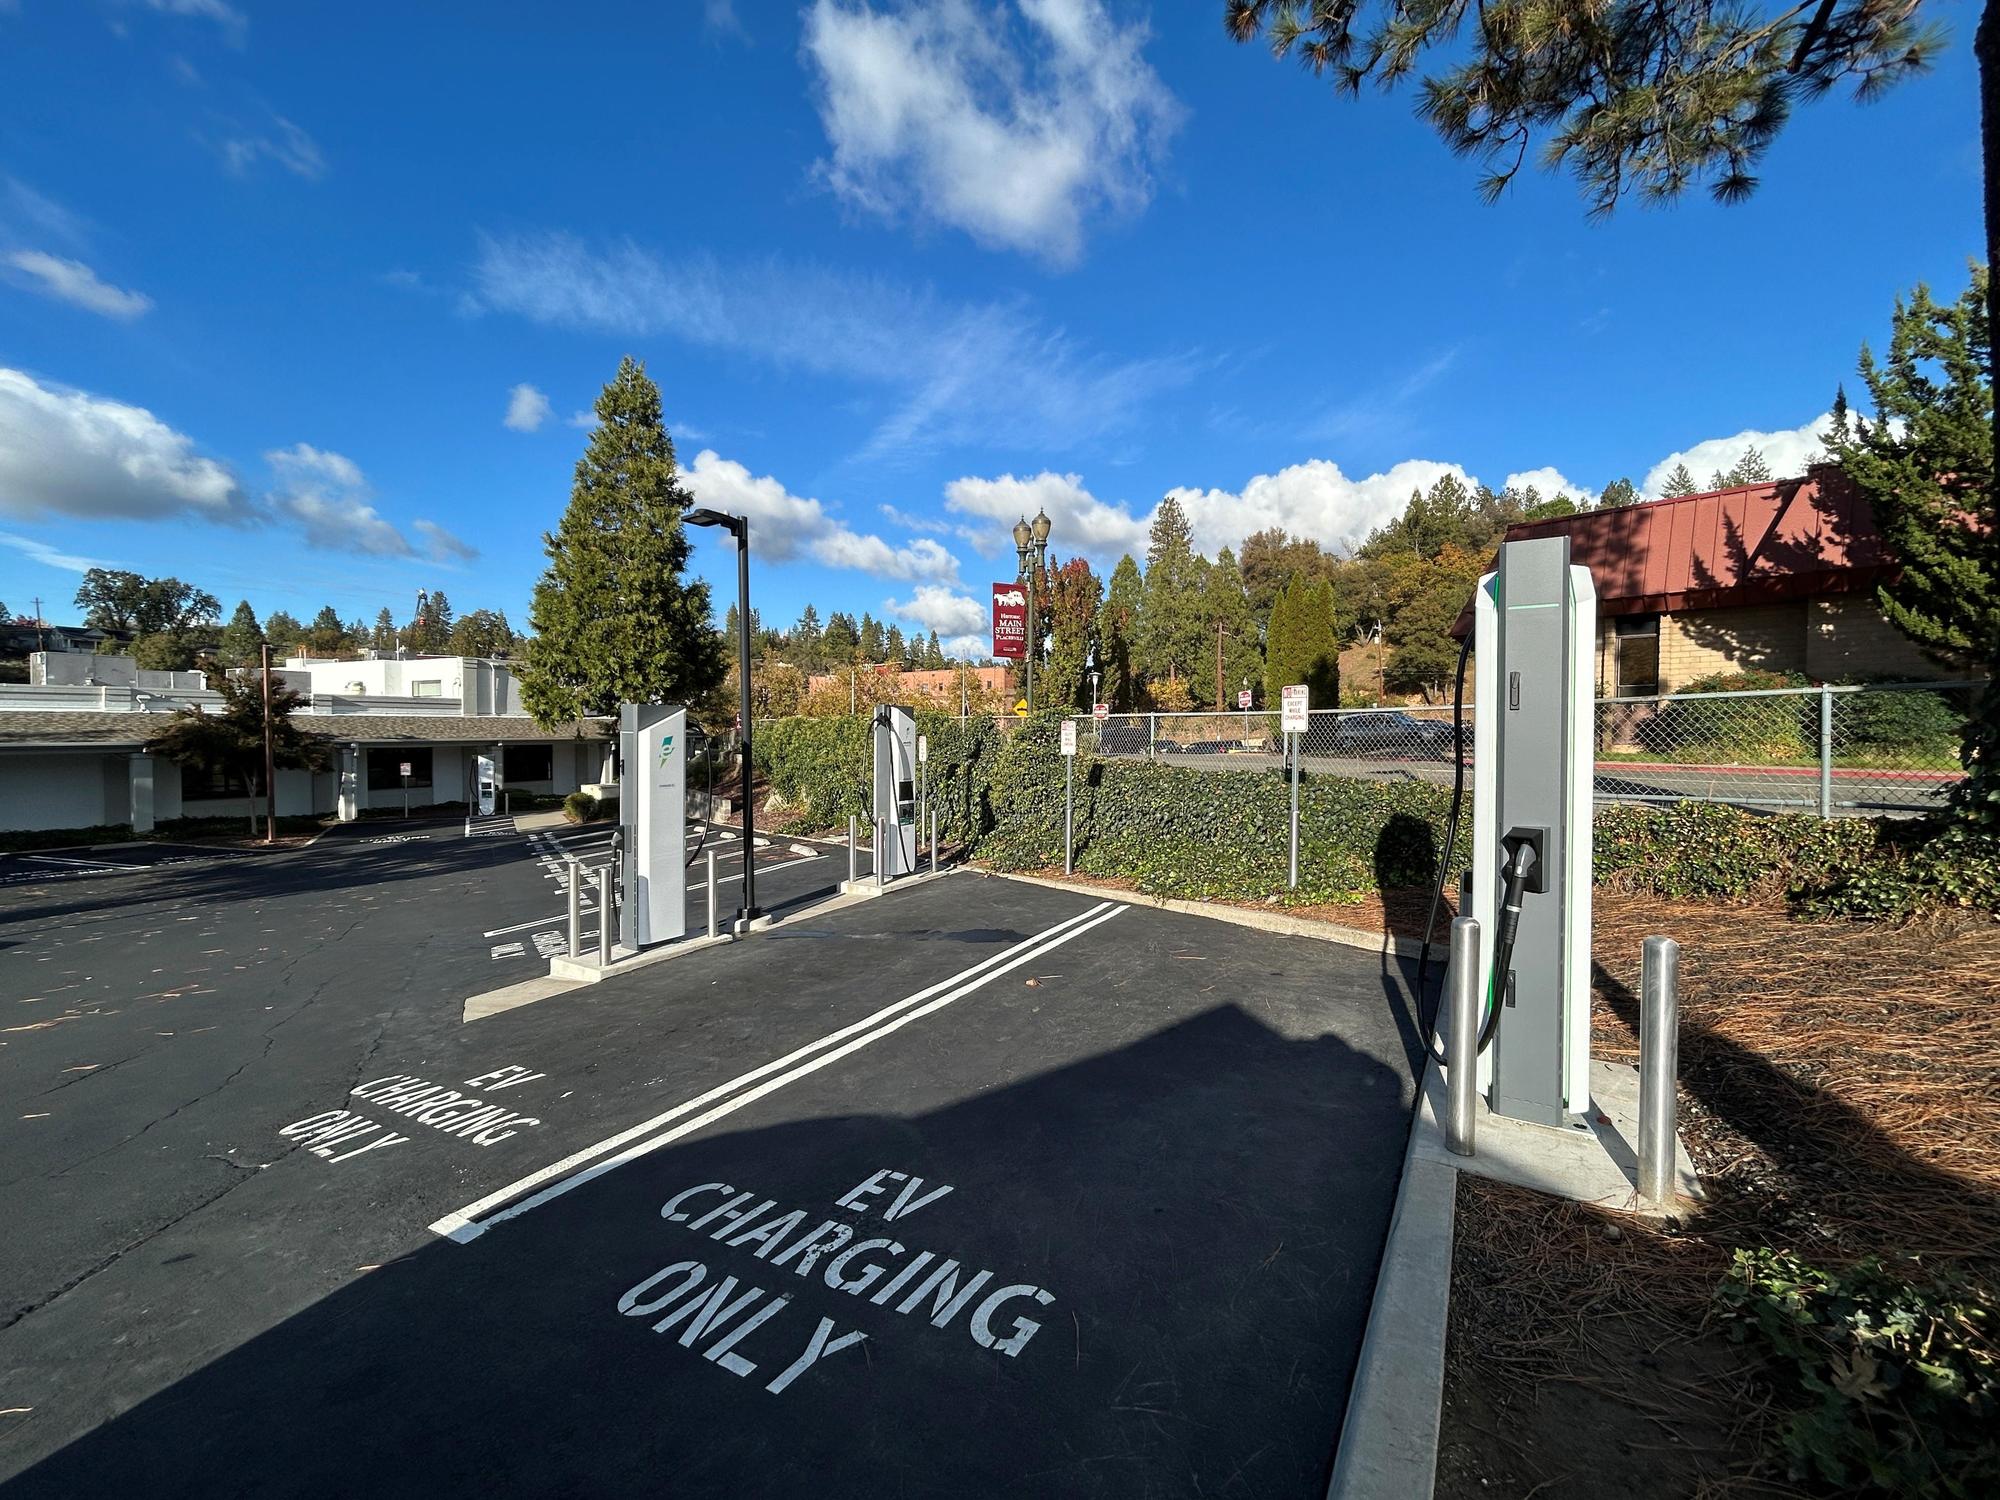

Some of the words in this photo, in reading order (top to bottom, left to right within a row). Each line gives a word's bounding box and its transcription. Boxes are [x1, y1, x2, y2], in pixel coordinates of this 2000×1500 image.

[464, 1065, 546, 1092] EV
[279, 1109, 410, 1163] ONLY
[350, 1075, 540, 1146] CHARGING
[835, 1168, 954, 1221] EV
[660, 1182, 1056, 1357] CHARGING
[617, 1261, 869, 1394] ONLY
